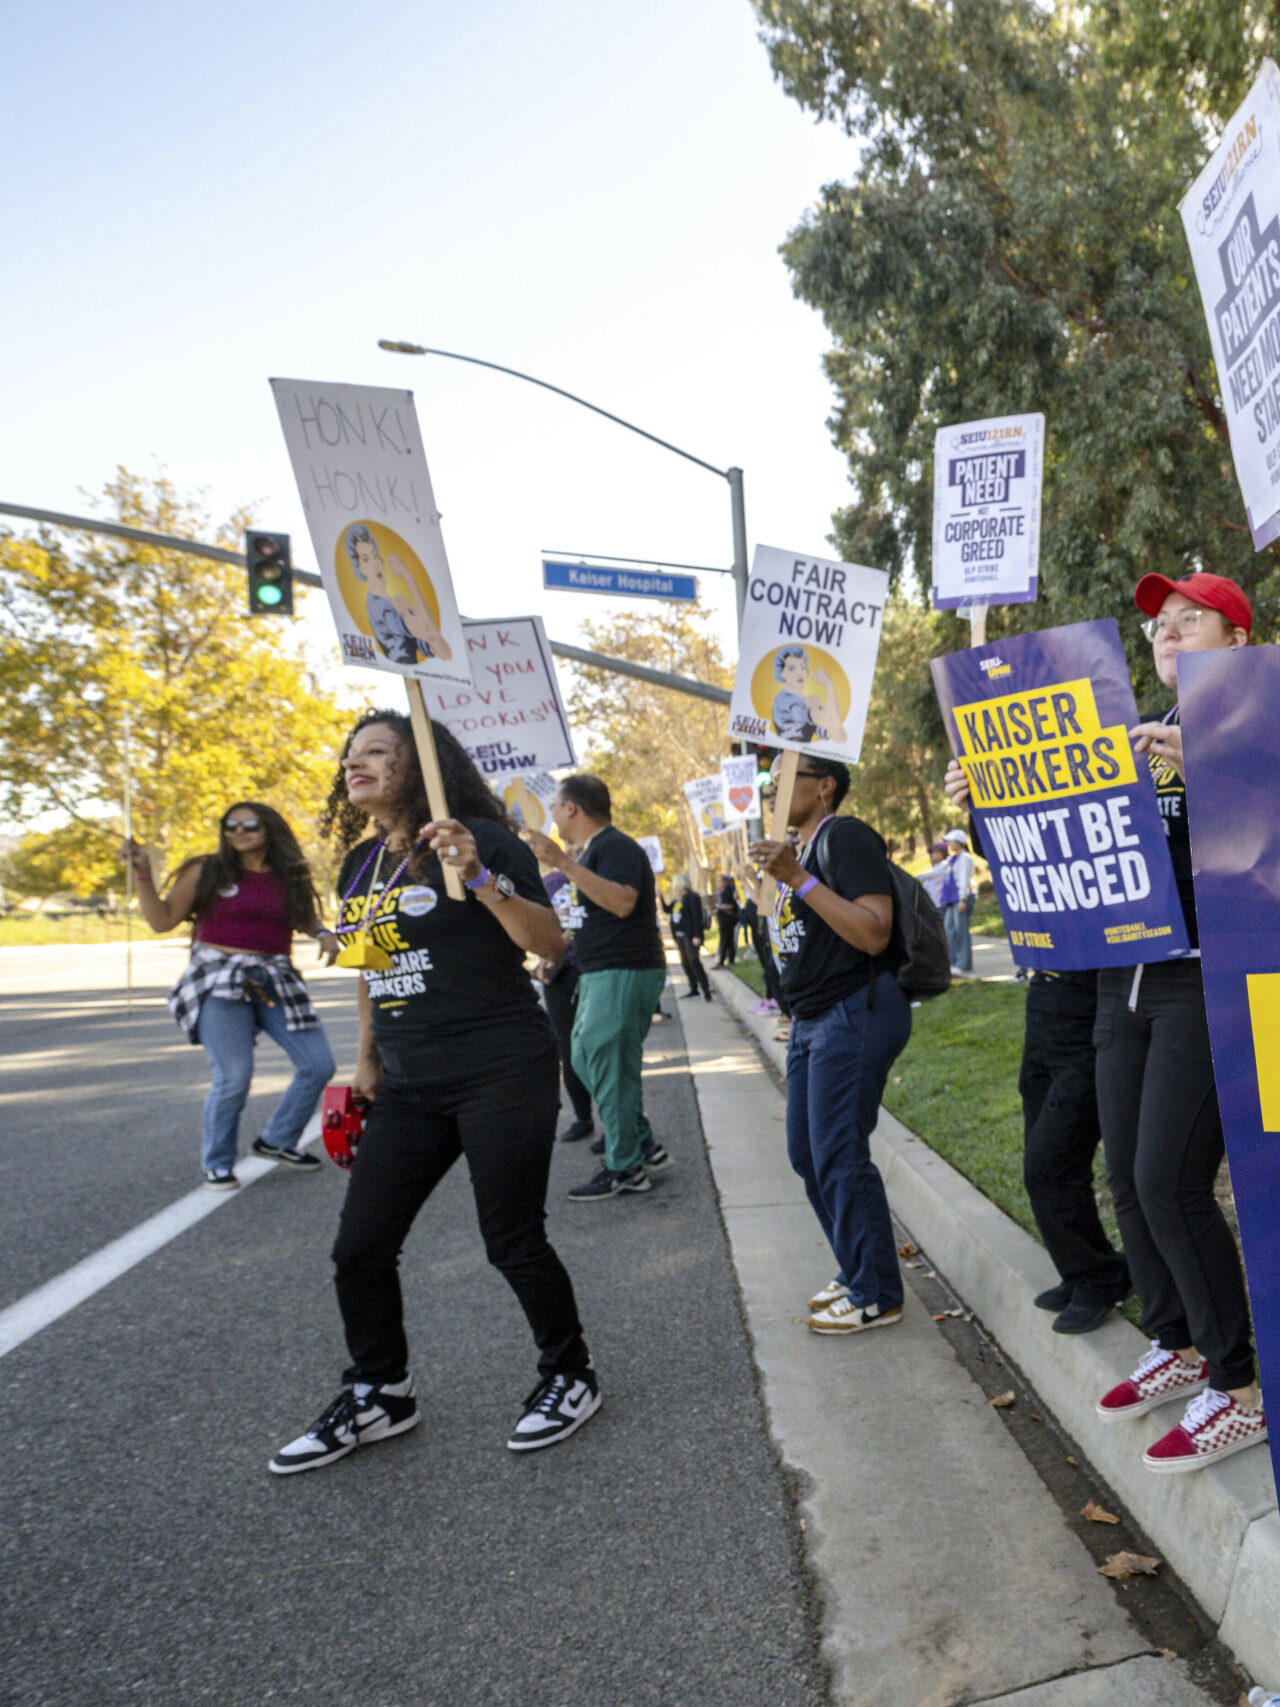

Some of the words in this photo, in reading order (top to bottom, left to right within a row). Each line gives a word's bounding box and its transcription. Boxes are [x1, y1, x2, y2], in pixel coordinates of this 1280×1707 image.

[1202, 113, 1257, 219] SEIU121RN
[1227, 214, 1256, 287] OUR
[1229, 345, 1264, 416] NEED
[294, 393, 413, 456] HONK!
[959, 425, 1023, 446] SEIU121RN
[955, 453, 1020, 485] PATIENT
[309, 464, 422, 524] HONK!
[964, 477, 1007, 506] NEED
[945, 514, 1025, 543] CORPORATE
[961, 538, 1005, 563] GREED
[568, 568, 613, 588] Kaiser
[617, 573, 674, 594] Hospital
[791, 559, 847, 595] FAIR
[750, 578, 882, 628] CONTRACT
[466, 629, 520, 652] NK
[778, 611, 844, 648] NOW!
[437, 688, 518, 711] LOVE
[963, 690, 1084, 756] KAISER
[482, 753, 536, 773] UHW
[967, 735, 1121, 803] WORKERS
[984, 805, 1073, 864] WON'T
[1078, 795, 1141, 855] BE
[1000, 849, 1152, 914] SILENCED
[1009, 930, 1025, 946] ULP
[1024, 931, 1055, 949] STRIKE
